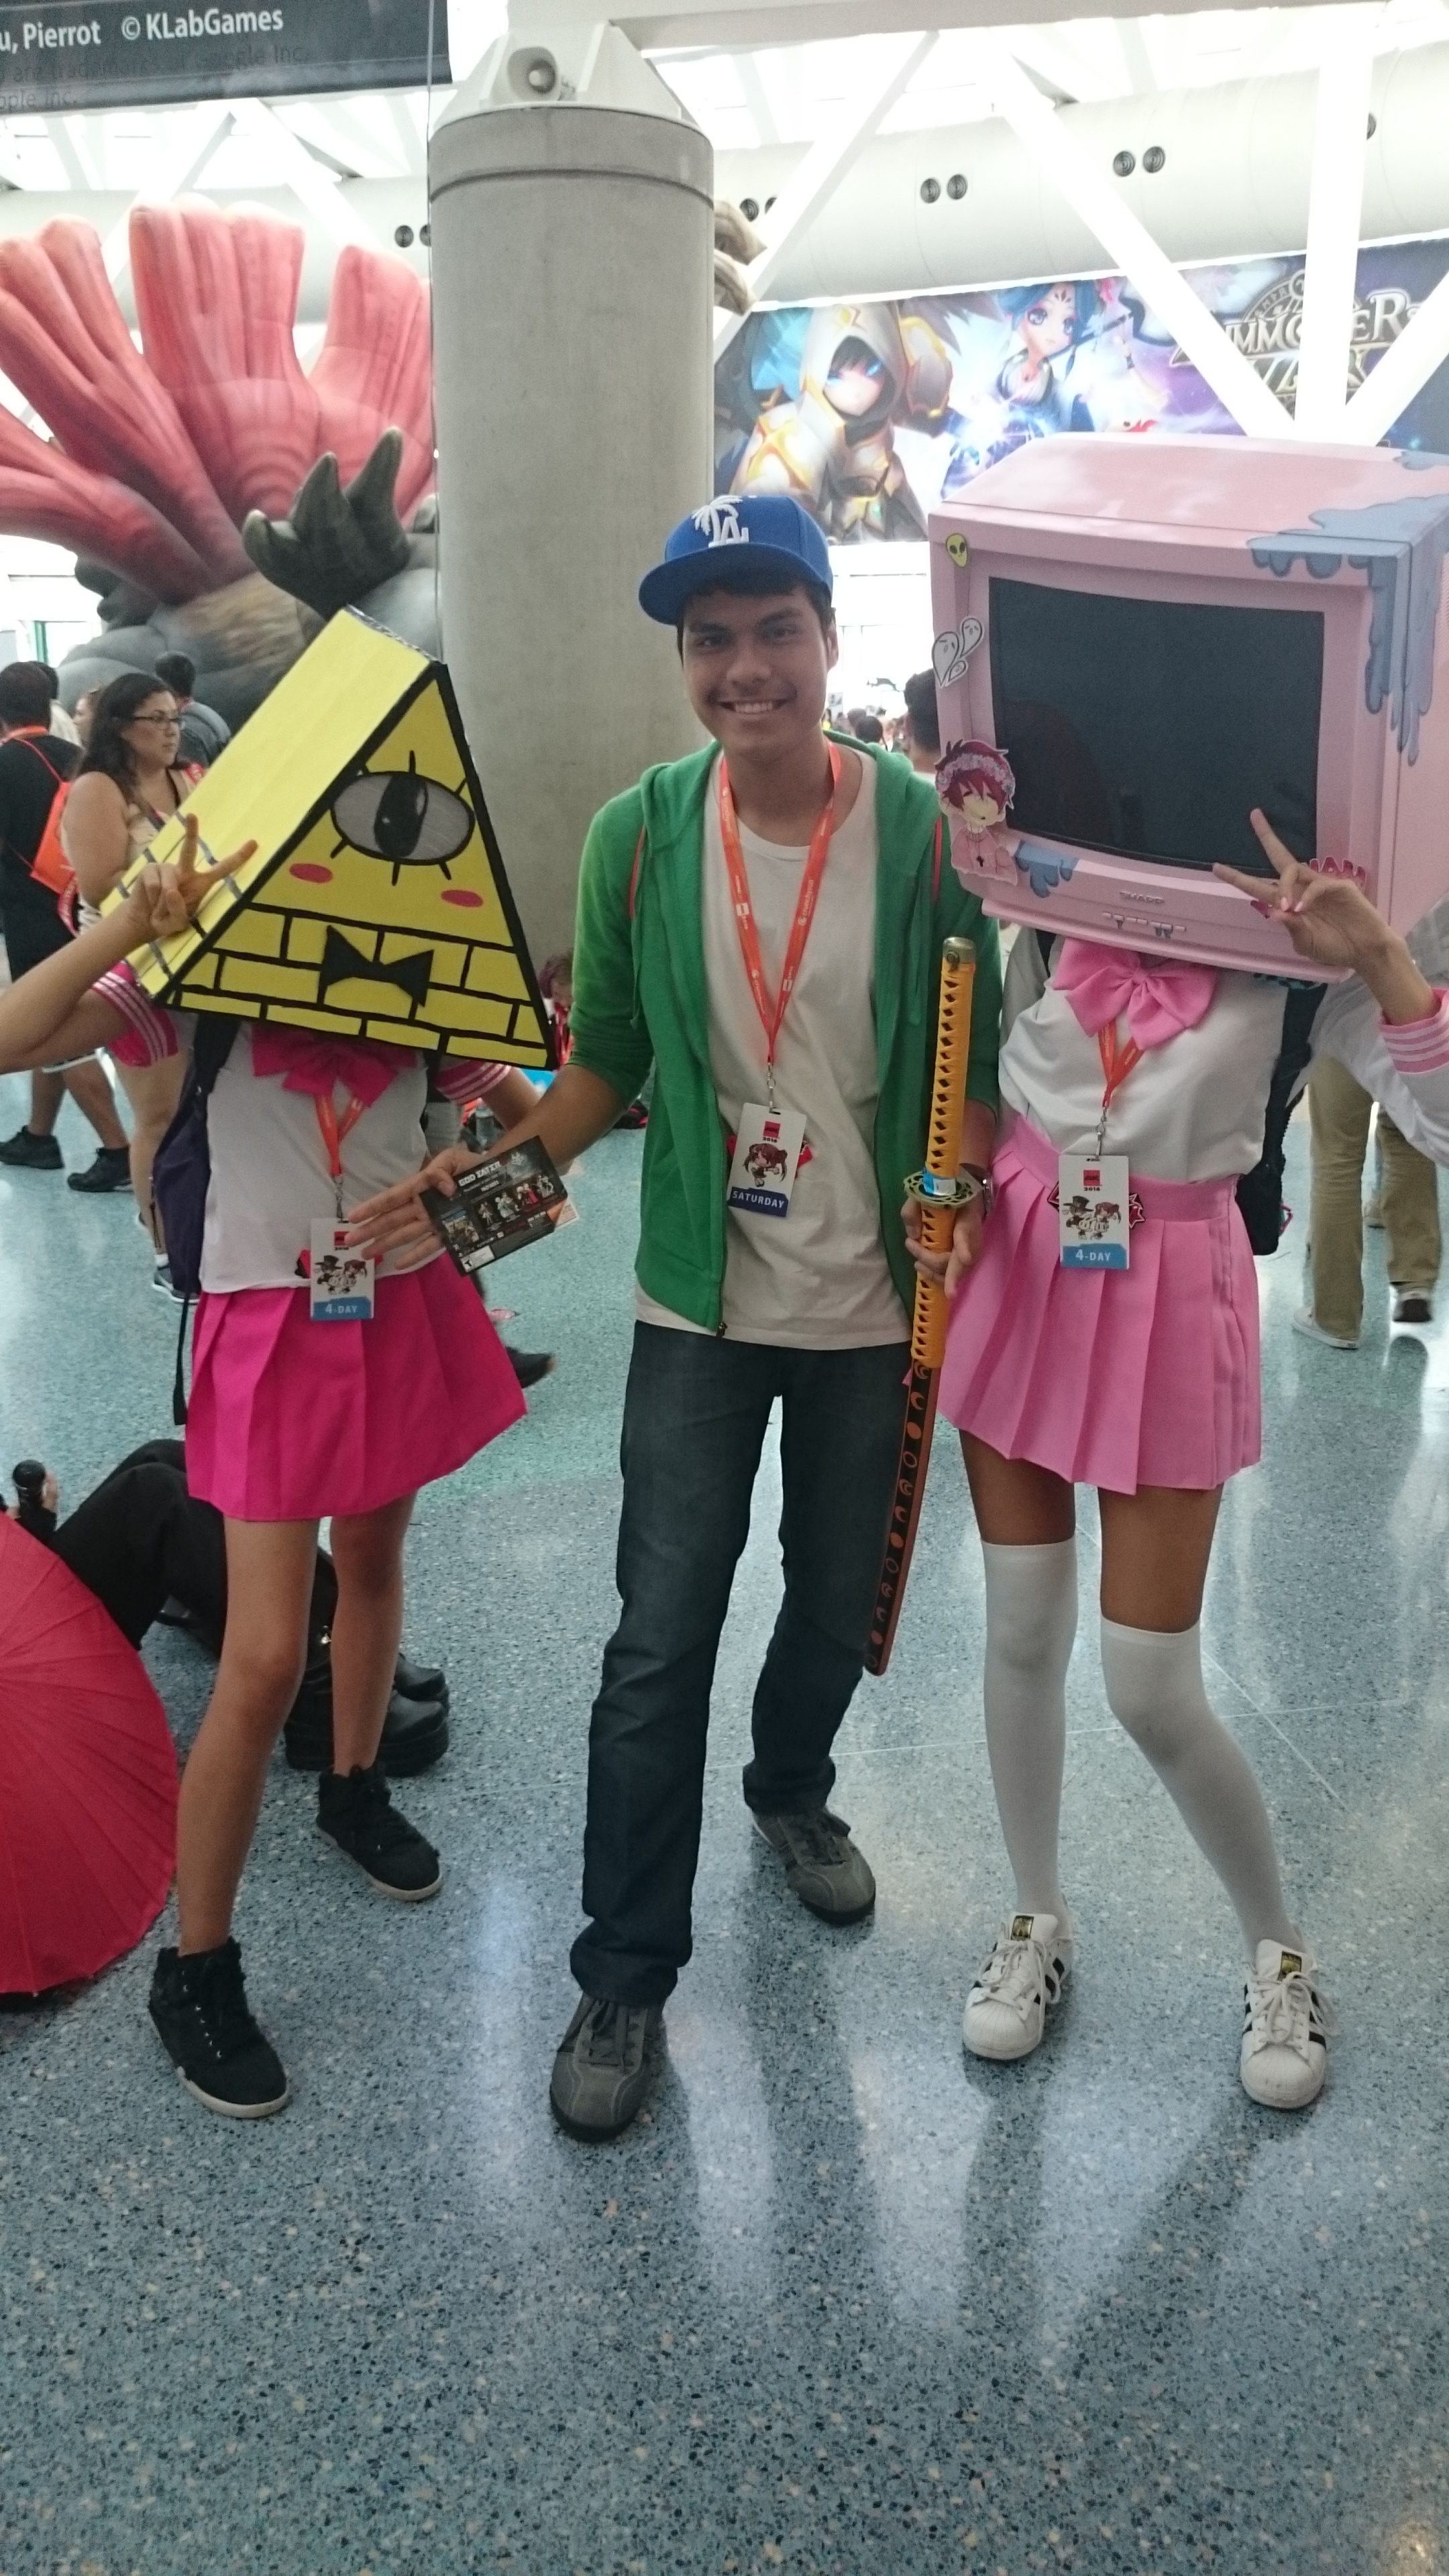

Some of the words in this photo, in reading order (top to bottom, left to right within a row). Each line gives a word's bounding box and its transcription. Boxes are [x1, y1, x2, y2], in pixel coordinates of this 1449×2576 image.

[23, 21, 101, 50] Pierrot
[146, 8, 284, 40] KLabGames
[732, 1190, 785, 1209] SATURDAY
[1075, 1249, 1111, 1261] 4-DAY
